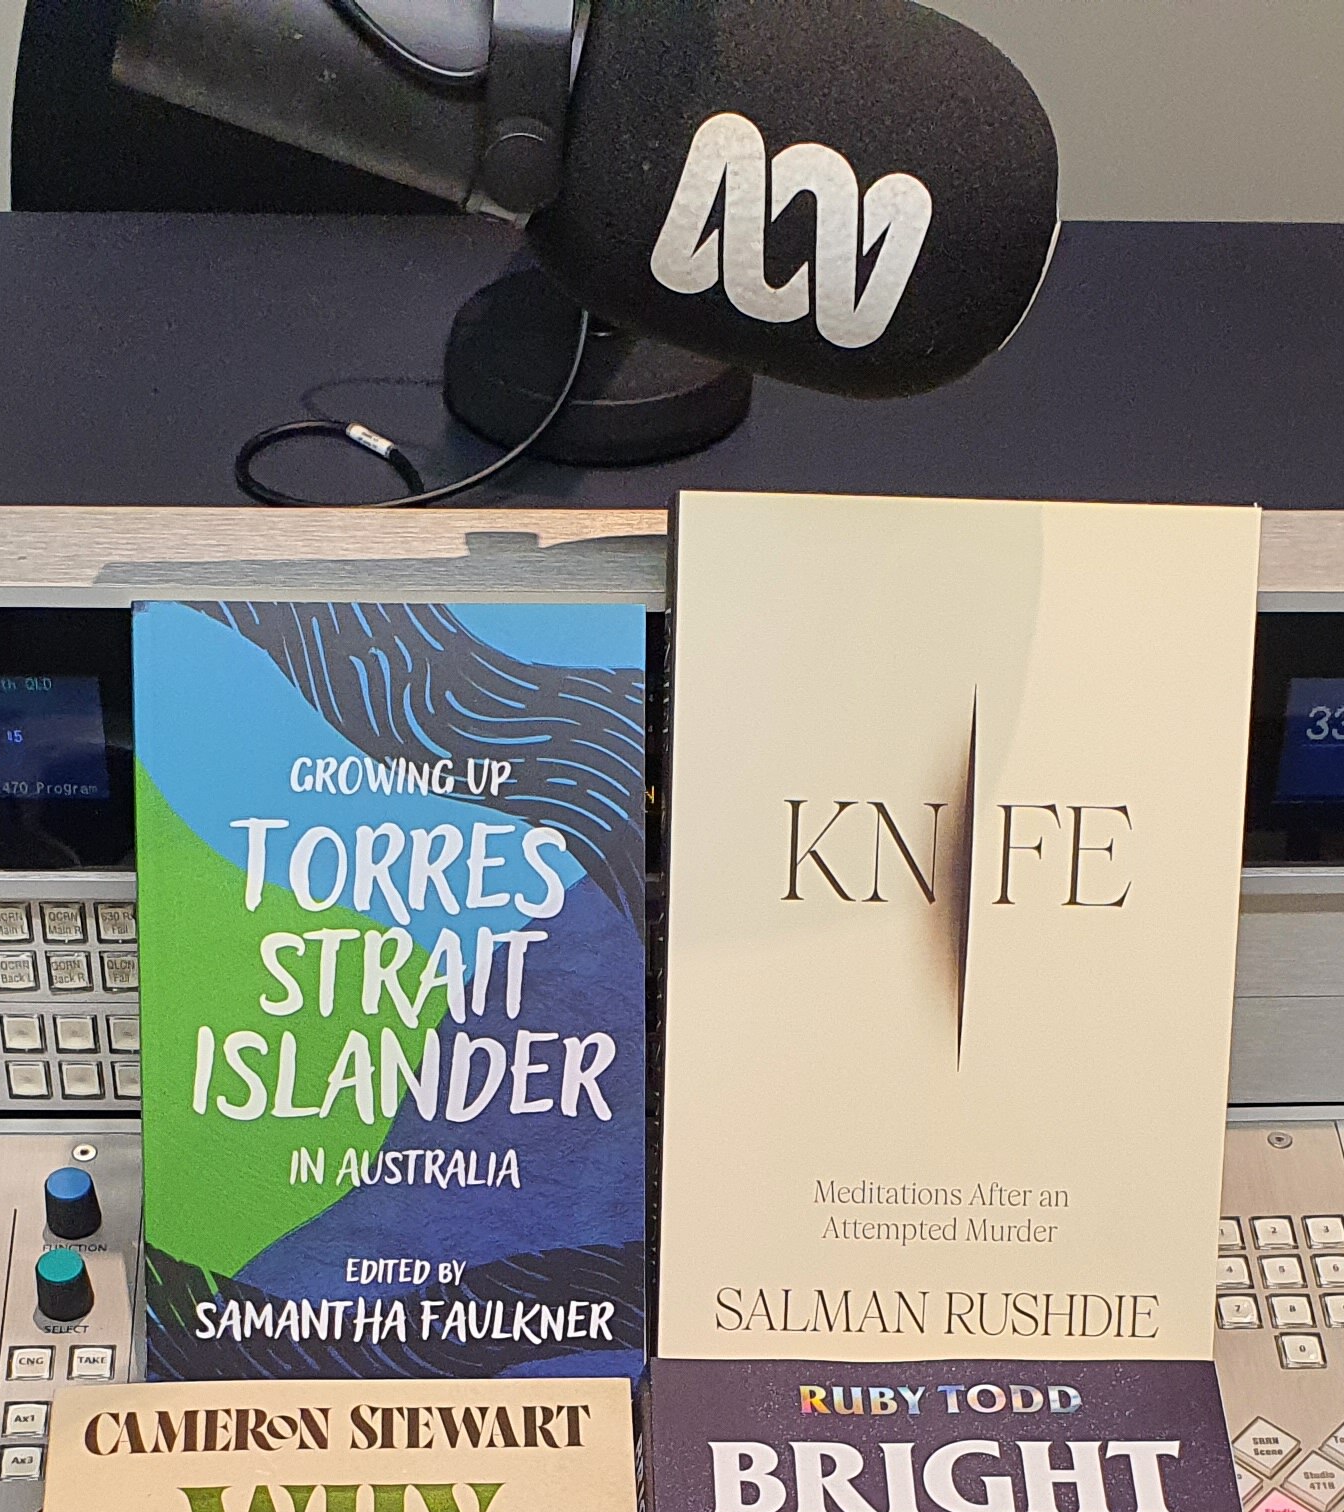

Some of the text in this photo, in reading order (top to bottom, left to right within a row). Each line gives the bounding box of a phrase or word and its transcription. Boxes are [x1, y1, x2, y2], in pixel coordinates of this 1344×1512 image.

[2, 781, 28, 794] 470
[36, 781, 97, 796] Program
[290, 757, 512, 796] GROWING UP
[229, 817, 568, 927] TORRES
[259, 927, 548, 1028] STRAIT
[193, 1026, 616, 1125] ISLANDER
[290, 1147, 521, 1189] IN AUSTRALIA
[813, 1179, 1069, 1208] Meditations After an
[821, 1217, 1058, 1246] Attempted Murder
[345, 1258, 466, 1286] EDITED BY
[195, 1298, 615, 1346] SAMANTHA FAULKNER
[714, 1287, 1160, 1339] SALMAN RUSHDIE
[799, 1383, 1082, 1416] RUBY TODD
[84, 1404, 591, 1456] CAMERON STEWART
